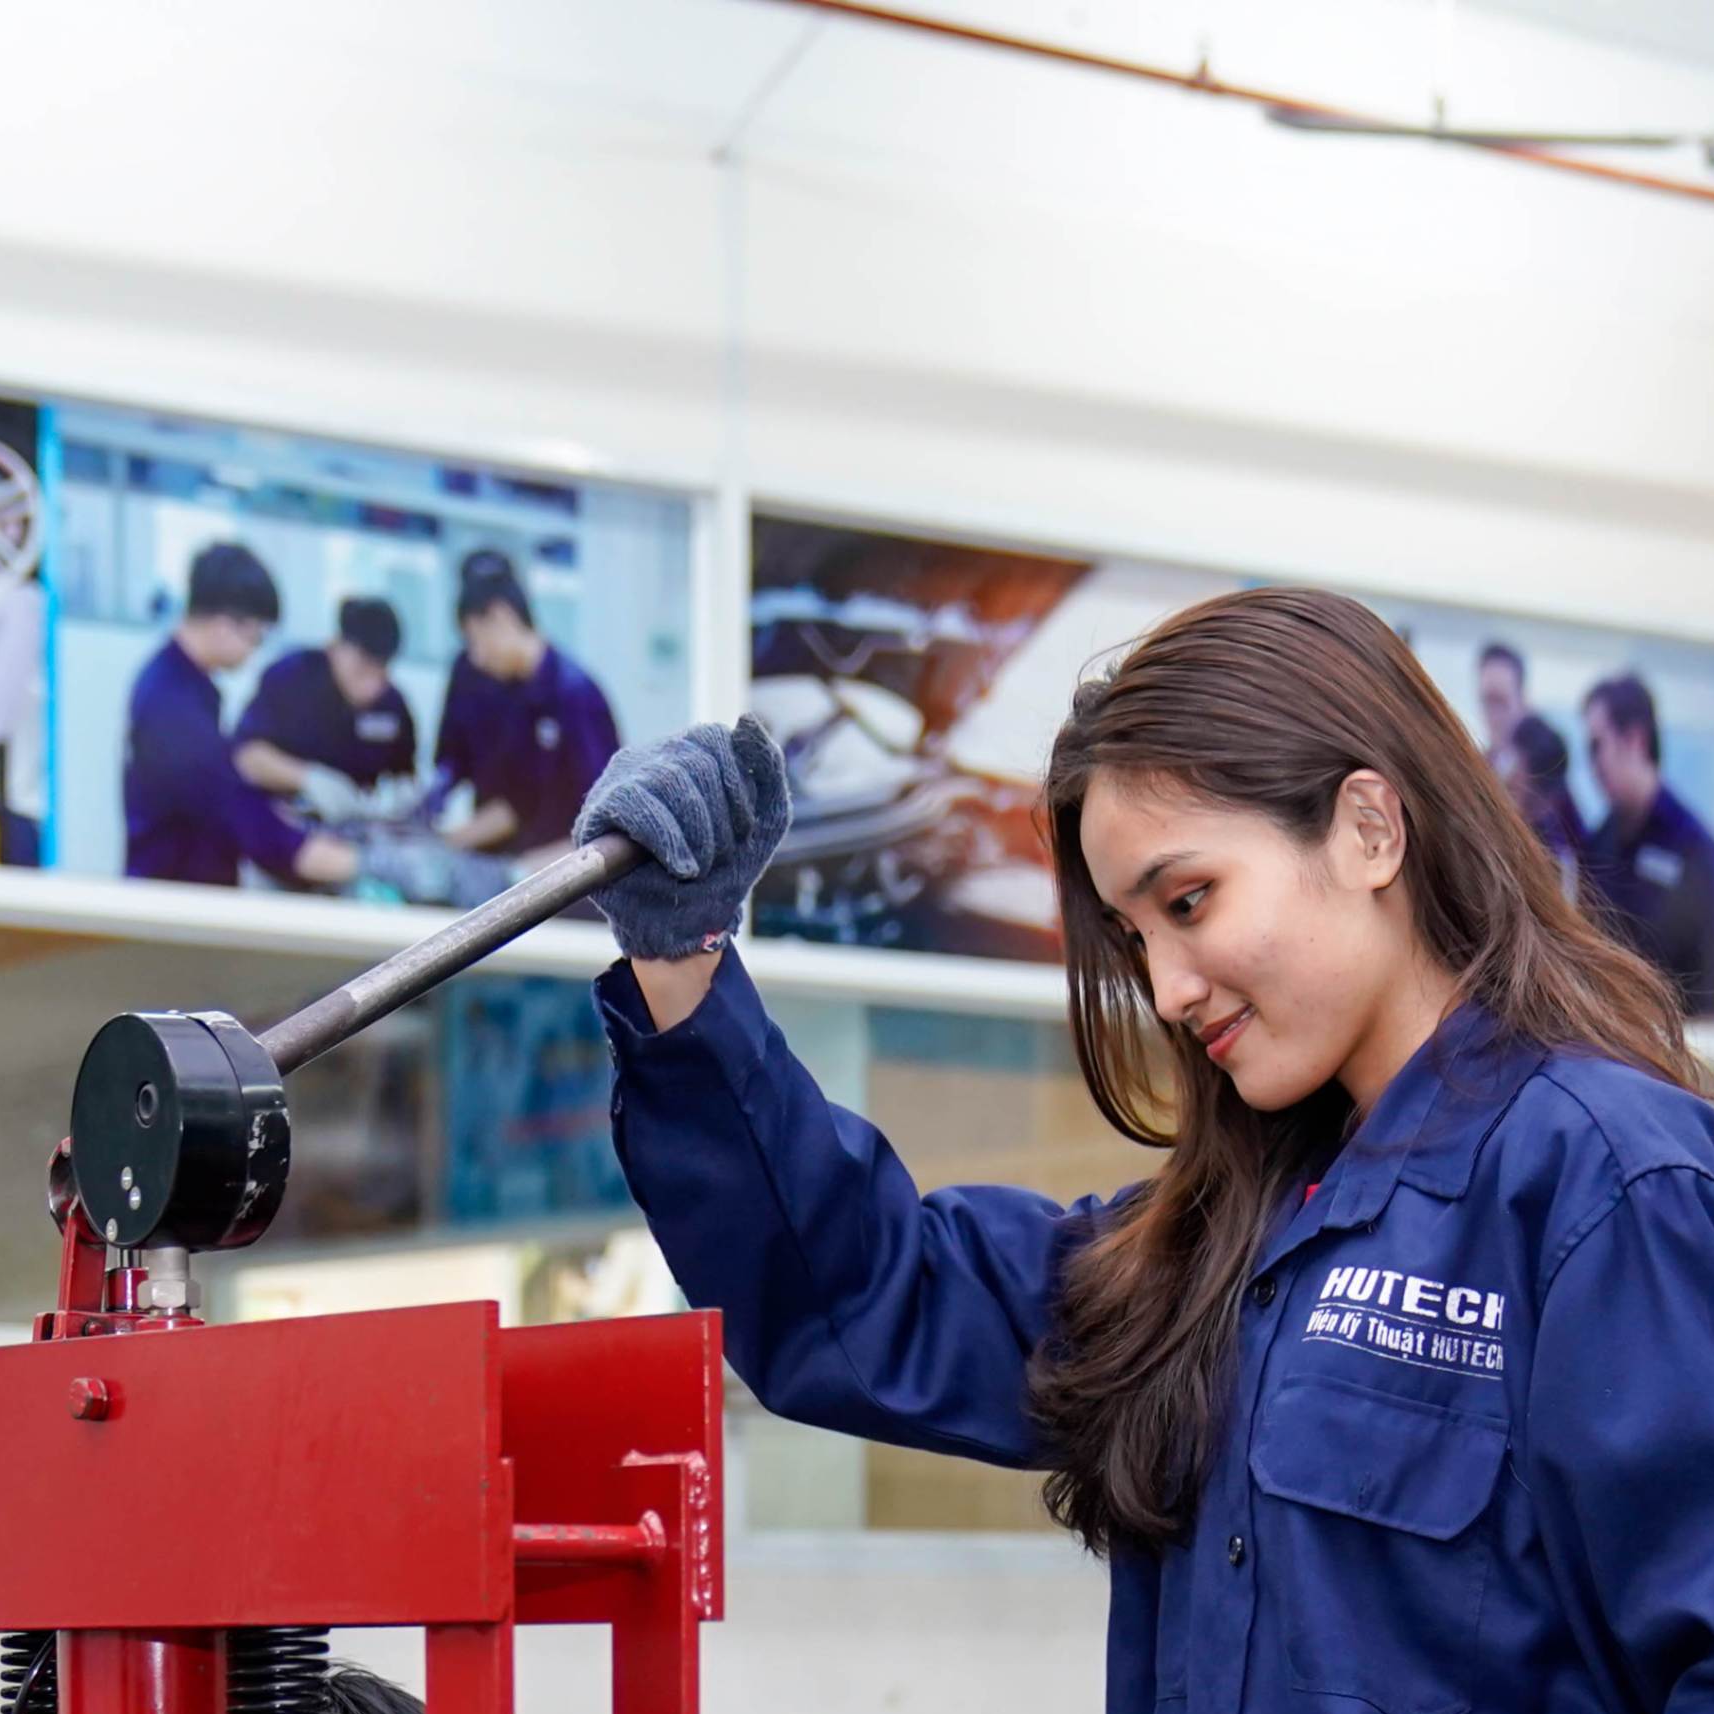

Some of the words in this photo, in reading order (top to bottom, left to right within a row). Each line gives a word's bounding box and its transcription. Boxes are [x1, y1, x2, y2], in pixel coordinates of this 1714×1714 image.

[1320, 1267, 1505, 1330] HUTECH
[1306, 1308, 1340, 1336] Viện
[1338, 1312, 1362, 1340] Kỹ
[1367, 1317, 1426, 1359] Thuật
[1431, 1333, 1504, 1371] HUTECH
